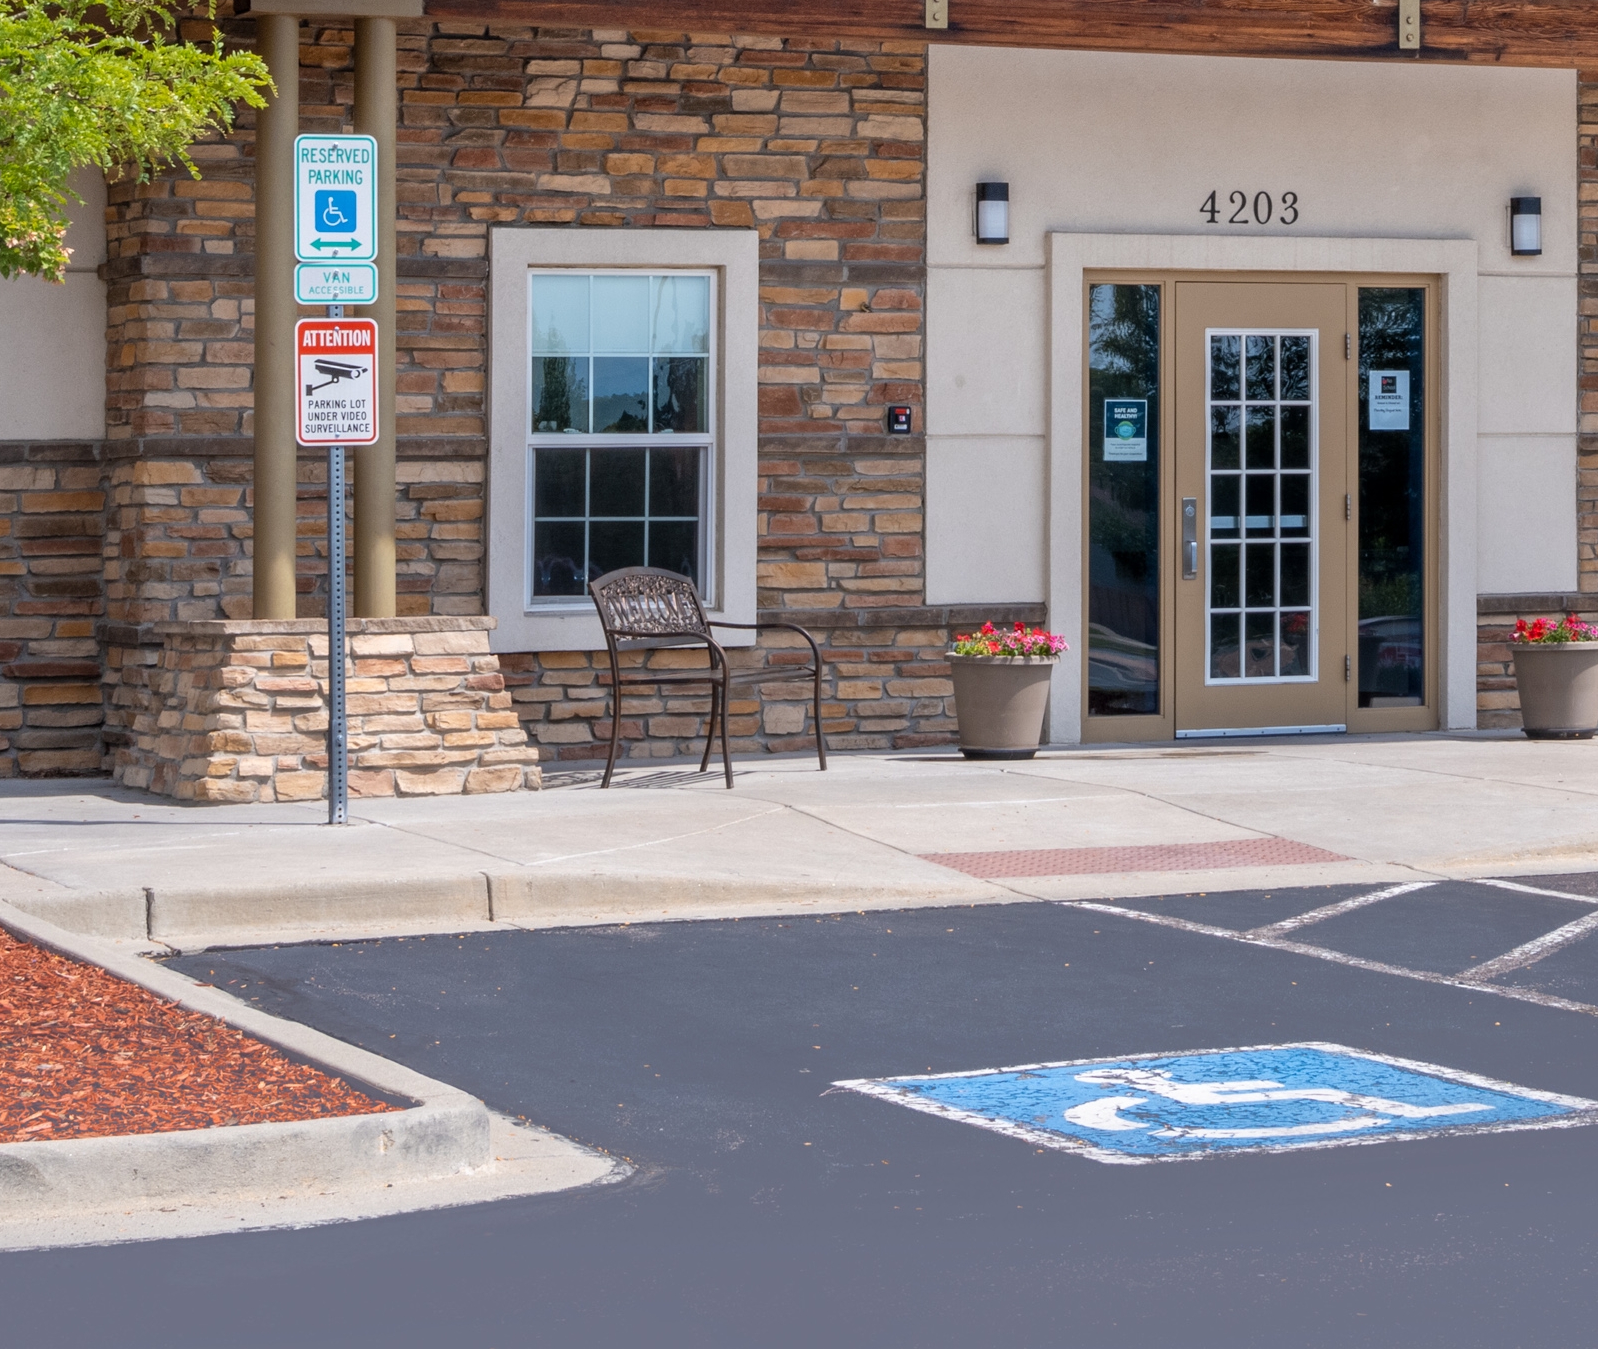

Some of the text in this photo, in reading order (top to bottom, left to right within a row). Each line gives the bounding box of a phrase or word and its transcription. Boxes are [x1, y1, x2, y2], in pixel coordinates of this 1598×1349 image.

[301, 148, 370, 163] RESERVED
[308, 169, 363, 185] PARKING
[1199, 190, 1299, 225] 4203
[323, 272, 350, 284] VAN
[308, 286, 364, 295] ACCESSIBLE
[303, 329, 371, 347] ATTENTION
[308, 399, 366, 409] PARKING LOT
[308, 411, 367, 421] UNDER VIDEO
[305, 424, 370, 433] SURVEILLANCE
